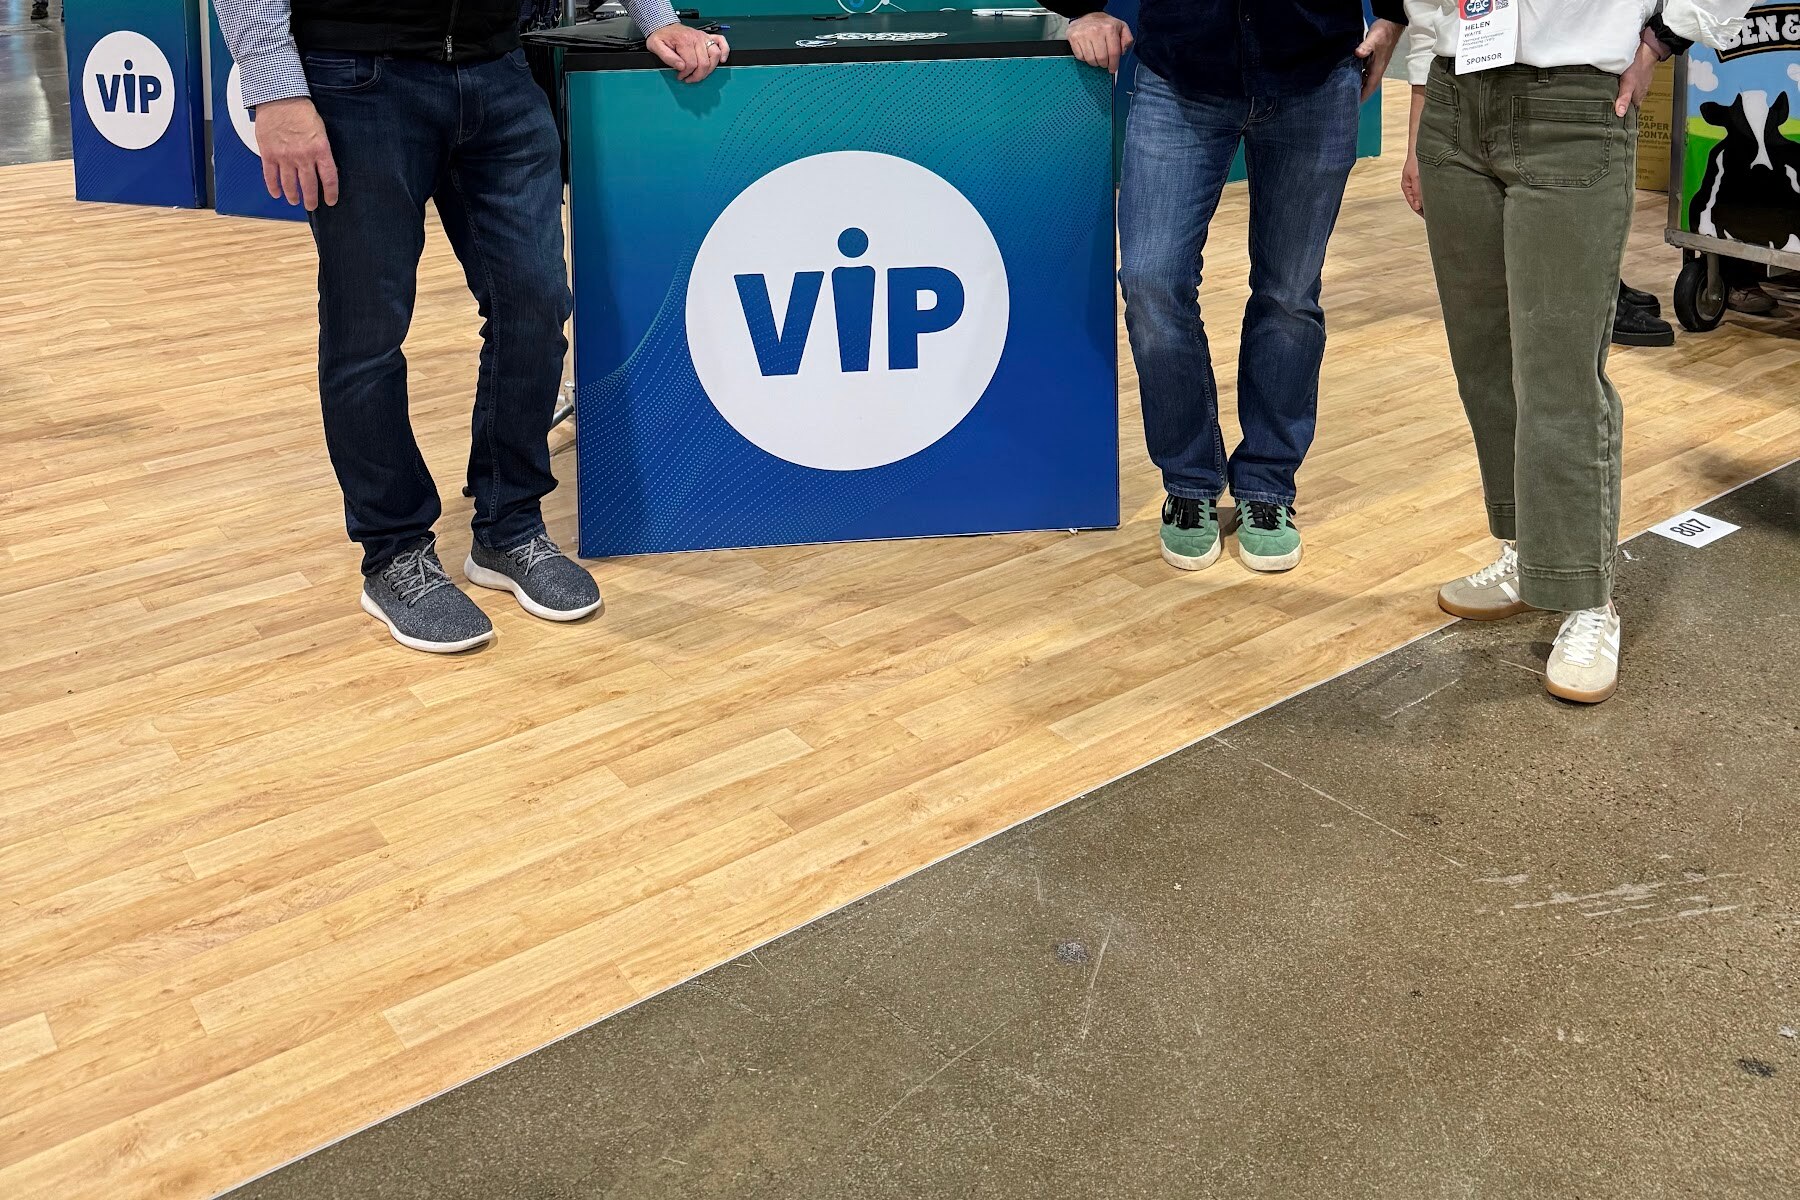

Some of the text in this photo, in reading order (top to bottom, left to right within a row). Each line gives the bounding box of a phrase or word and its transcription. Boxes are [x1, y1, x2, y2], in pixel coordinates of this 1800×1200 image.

[1464, 20, 1491, 32] HELEN
[1466, 52, 1503, 66] SPONSOR
[1638, 122, 1669, 131] PAPER
[1638, 130, 1672, 140] CONTA
[1669, 517, 1712, 537] 807
